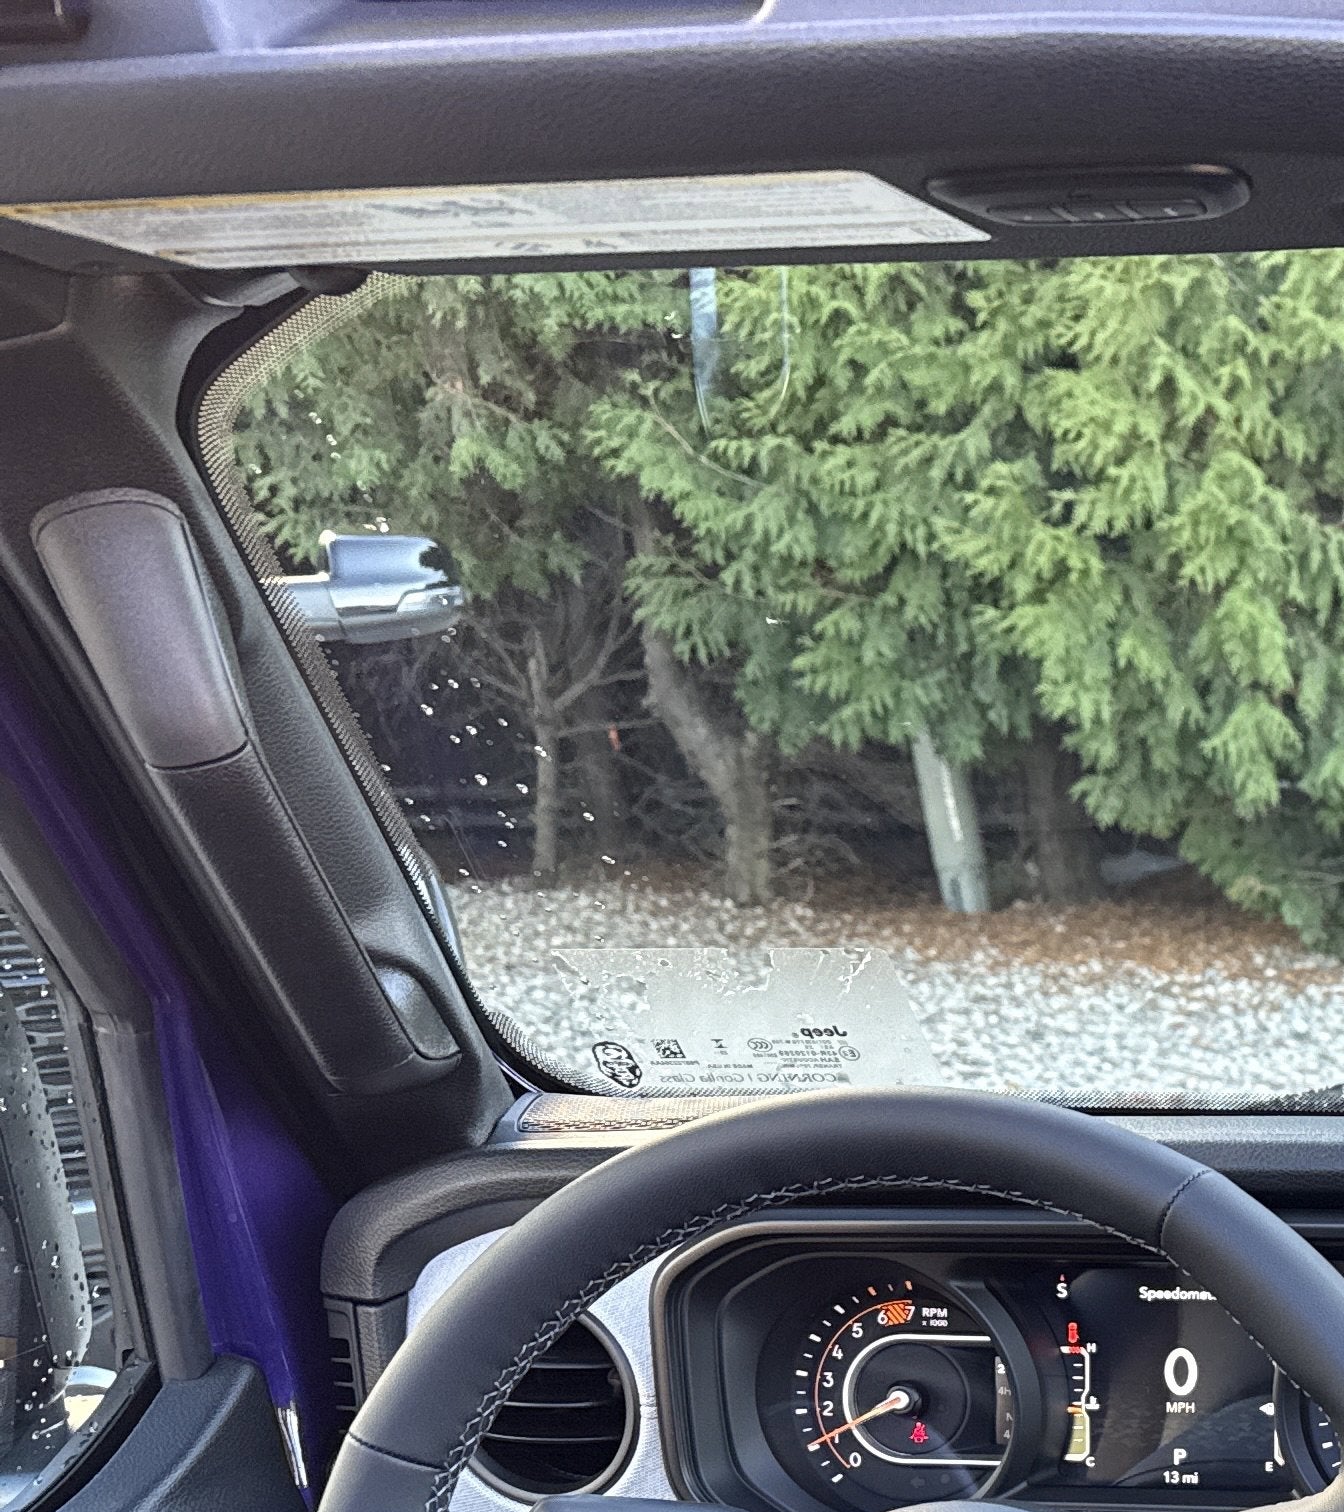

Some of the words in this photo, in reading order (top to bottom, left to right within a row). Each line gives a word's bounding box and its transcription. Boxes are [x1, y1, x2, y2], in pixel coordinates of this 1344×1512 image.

[1056, 1282, 1068, 1299] S
[877, 1310, 889, 1325] 6
[904, 1305, 916, 1321] 7
[922, 1307, 948, 1318] RPM
[852, 1322, 864, 1338] 5
[832, 1344, 844, 1360] 4
[1086, 1343, 1097, 1353] H
[1164, 1347, 1198, 1396] 0
[822, 1372, 834, 1388] 3
[822, 1401, 834, 1416] 2
[1166, 1402, 1196, 1414] MPH
[850, 1452, 862, 1467] 0
[1085, 1457, 1096, 1468] C
[1173, 1448, 1187, 1466] P
[1265, 1461, 1274, 1472] E
[1163, 1470, 1181, 1484] 13
[1182, 1471, 1199, 1484] mi
